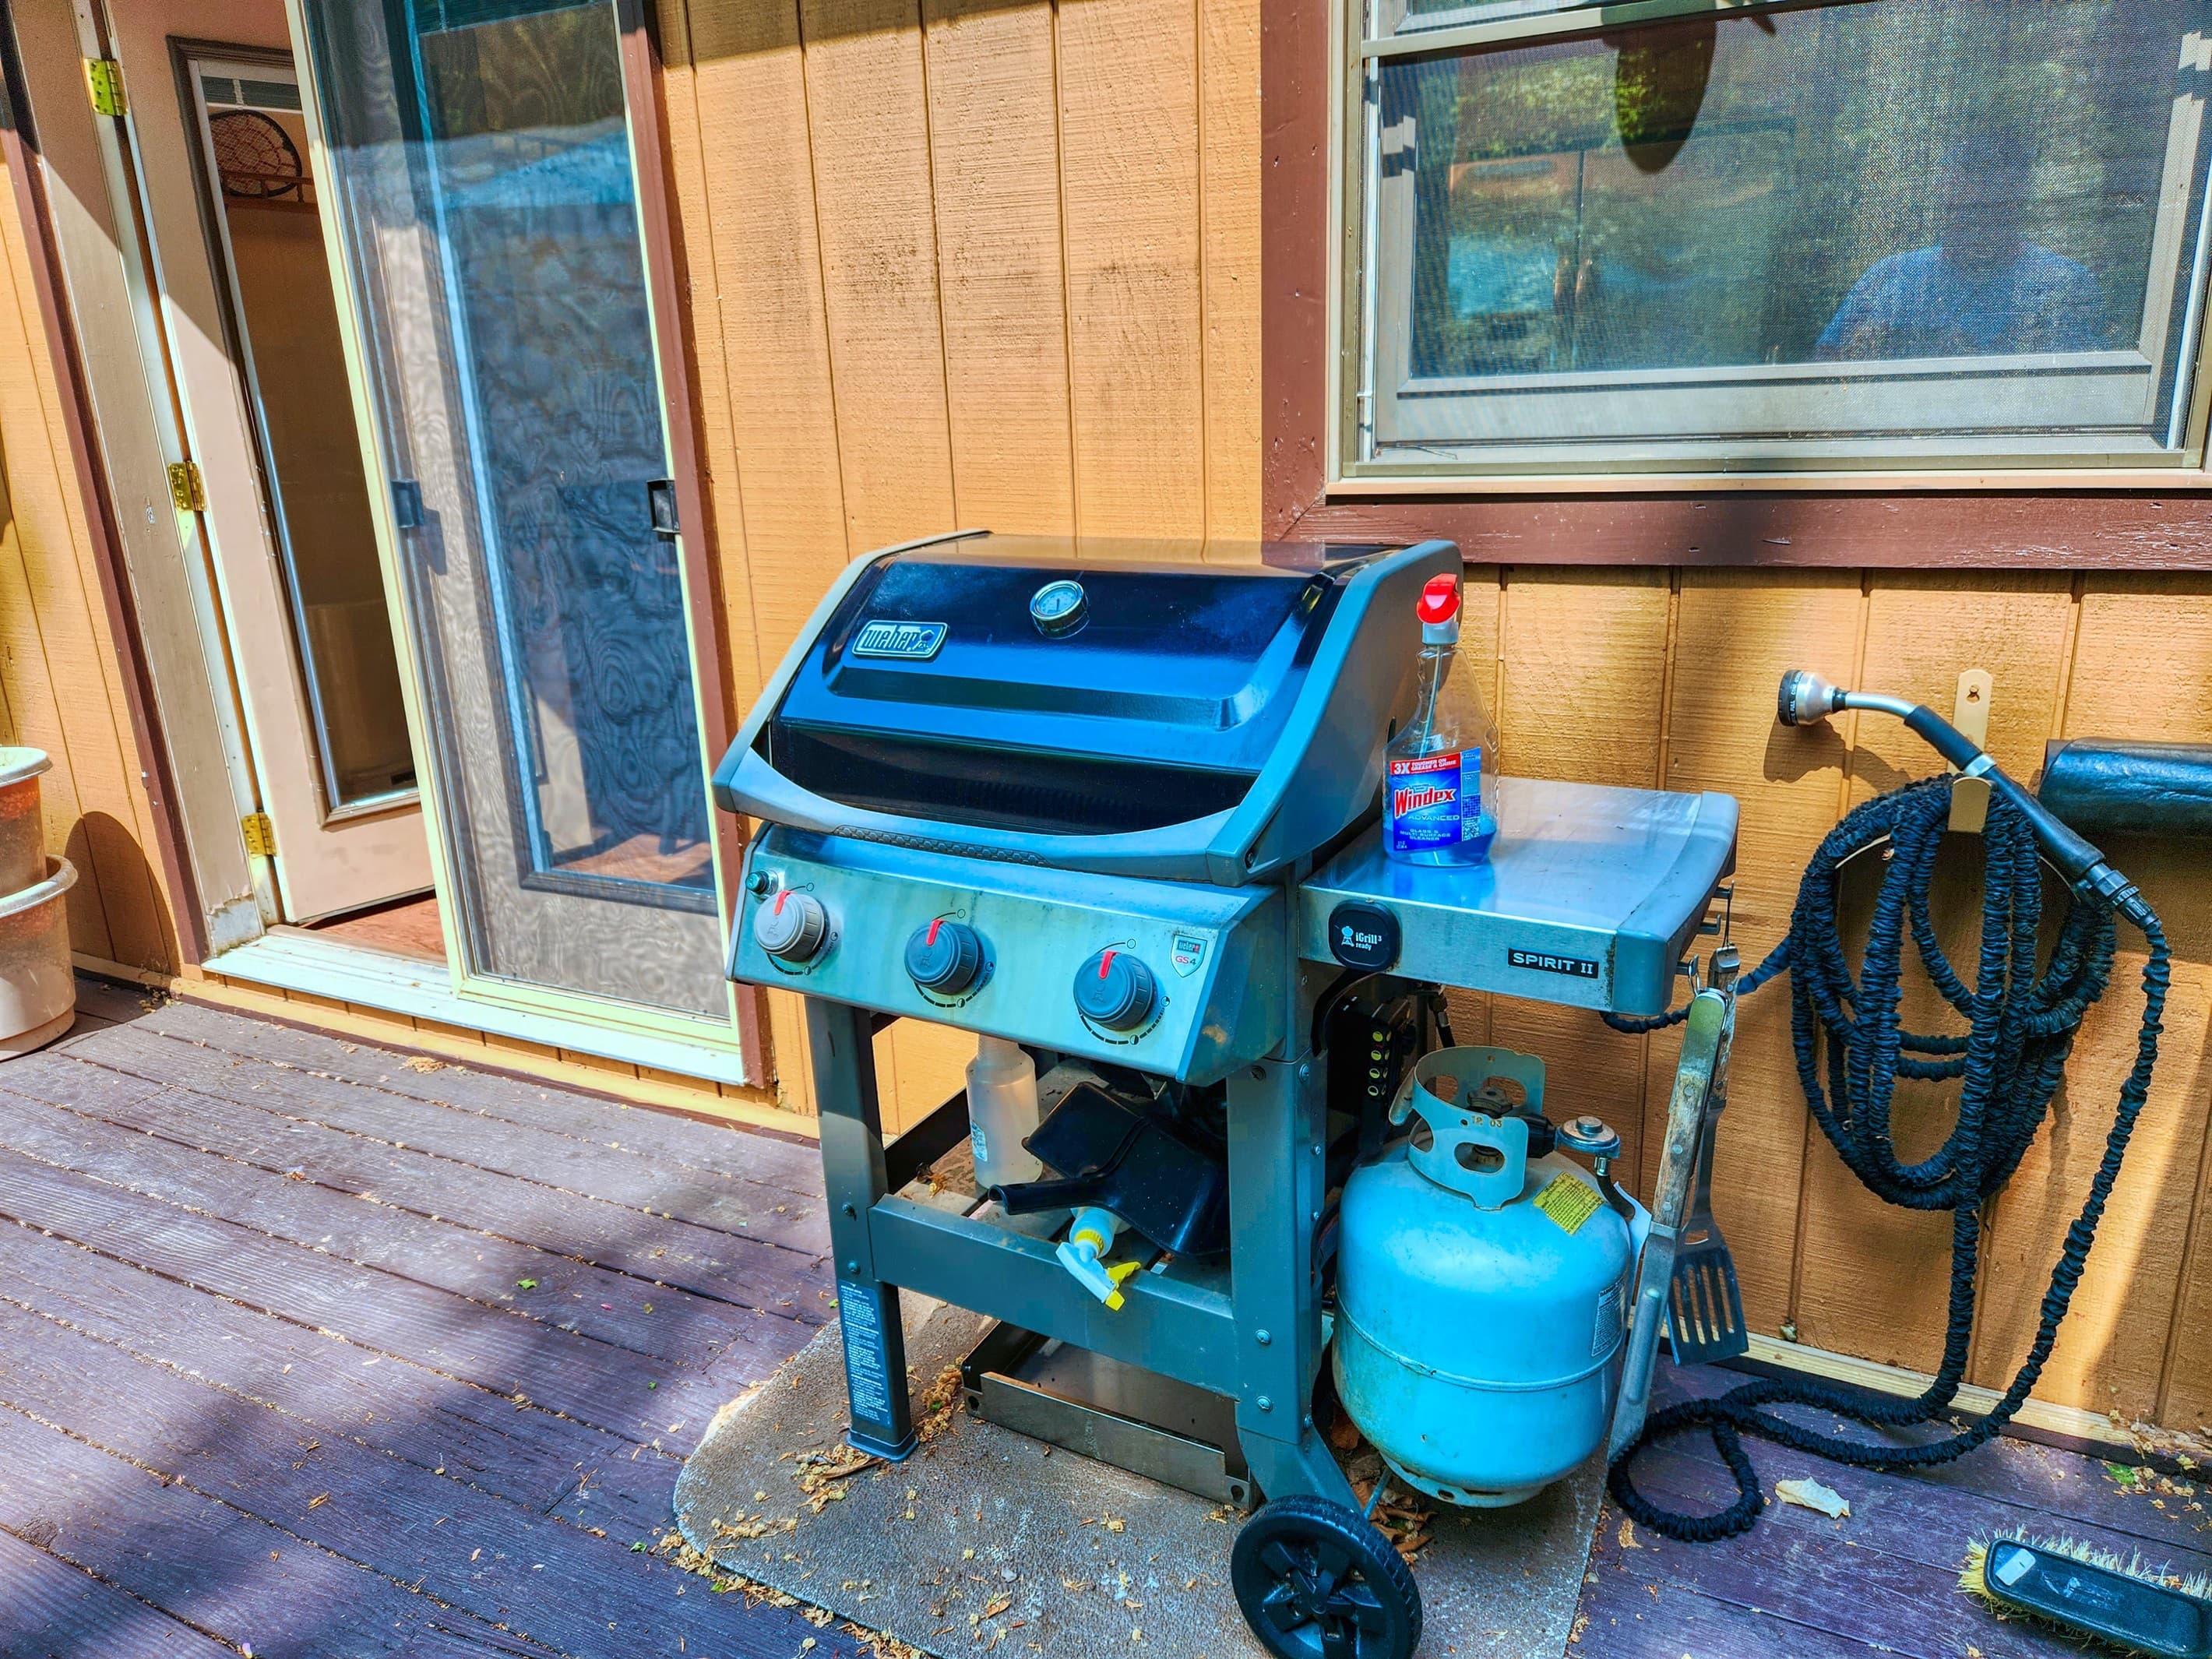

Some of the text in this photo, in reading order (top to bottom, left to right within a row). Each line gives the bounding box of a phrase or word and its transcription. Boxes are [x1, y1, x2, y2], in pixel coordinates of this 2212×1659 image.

[1393, 762, 1411, 775] 3X
[1395, 787, 1456, 818] Windex
[1355, 942, 1372, 951] ready
[1513, 953, 1594, 974] SPIRIT II
